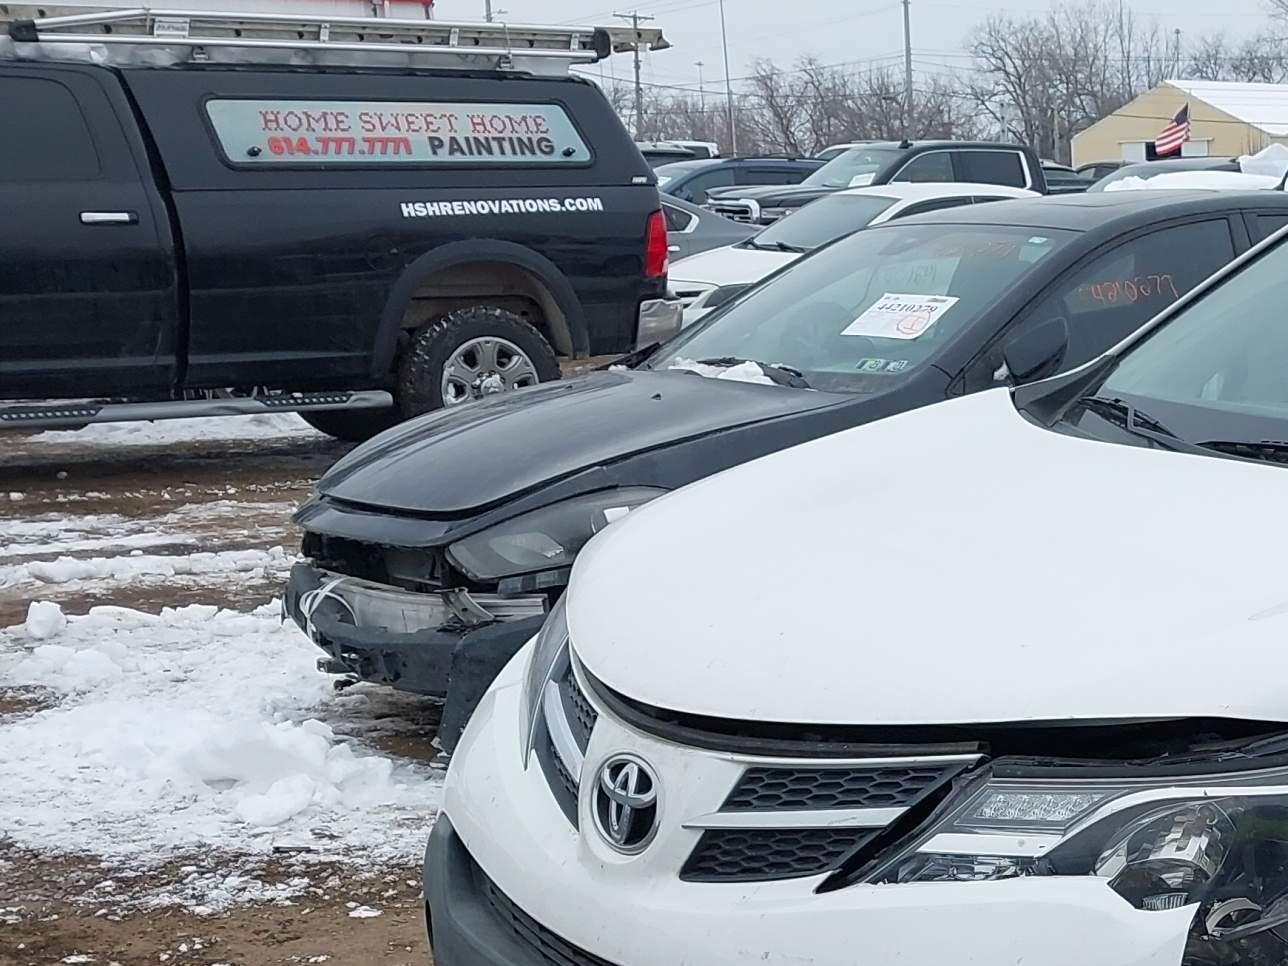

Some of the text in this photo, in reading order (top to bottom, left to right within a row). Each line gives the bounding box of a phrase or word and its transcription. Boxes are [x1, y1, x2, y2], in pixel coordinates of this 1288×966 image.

[259, 110, 549, 134] HOME SWEET HOME
[428, 136, 555, 156] PAINTING
[400, 197, 604, 217] HSHRENOVATIONS.COM
